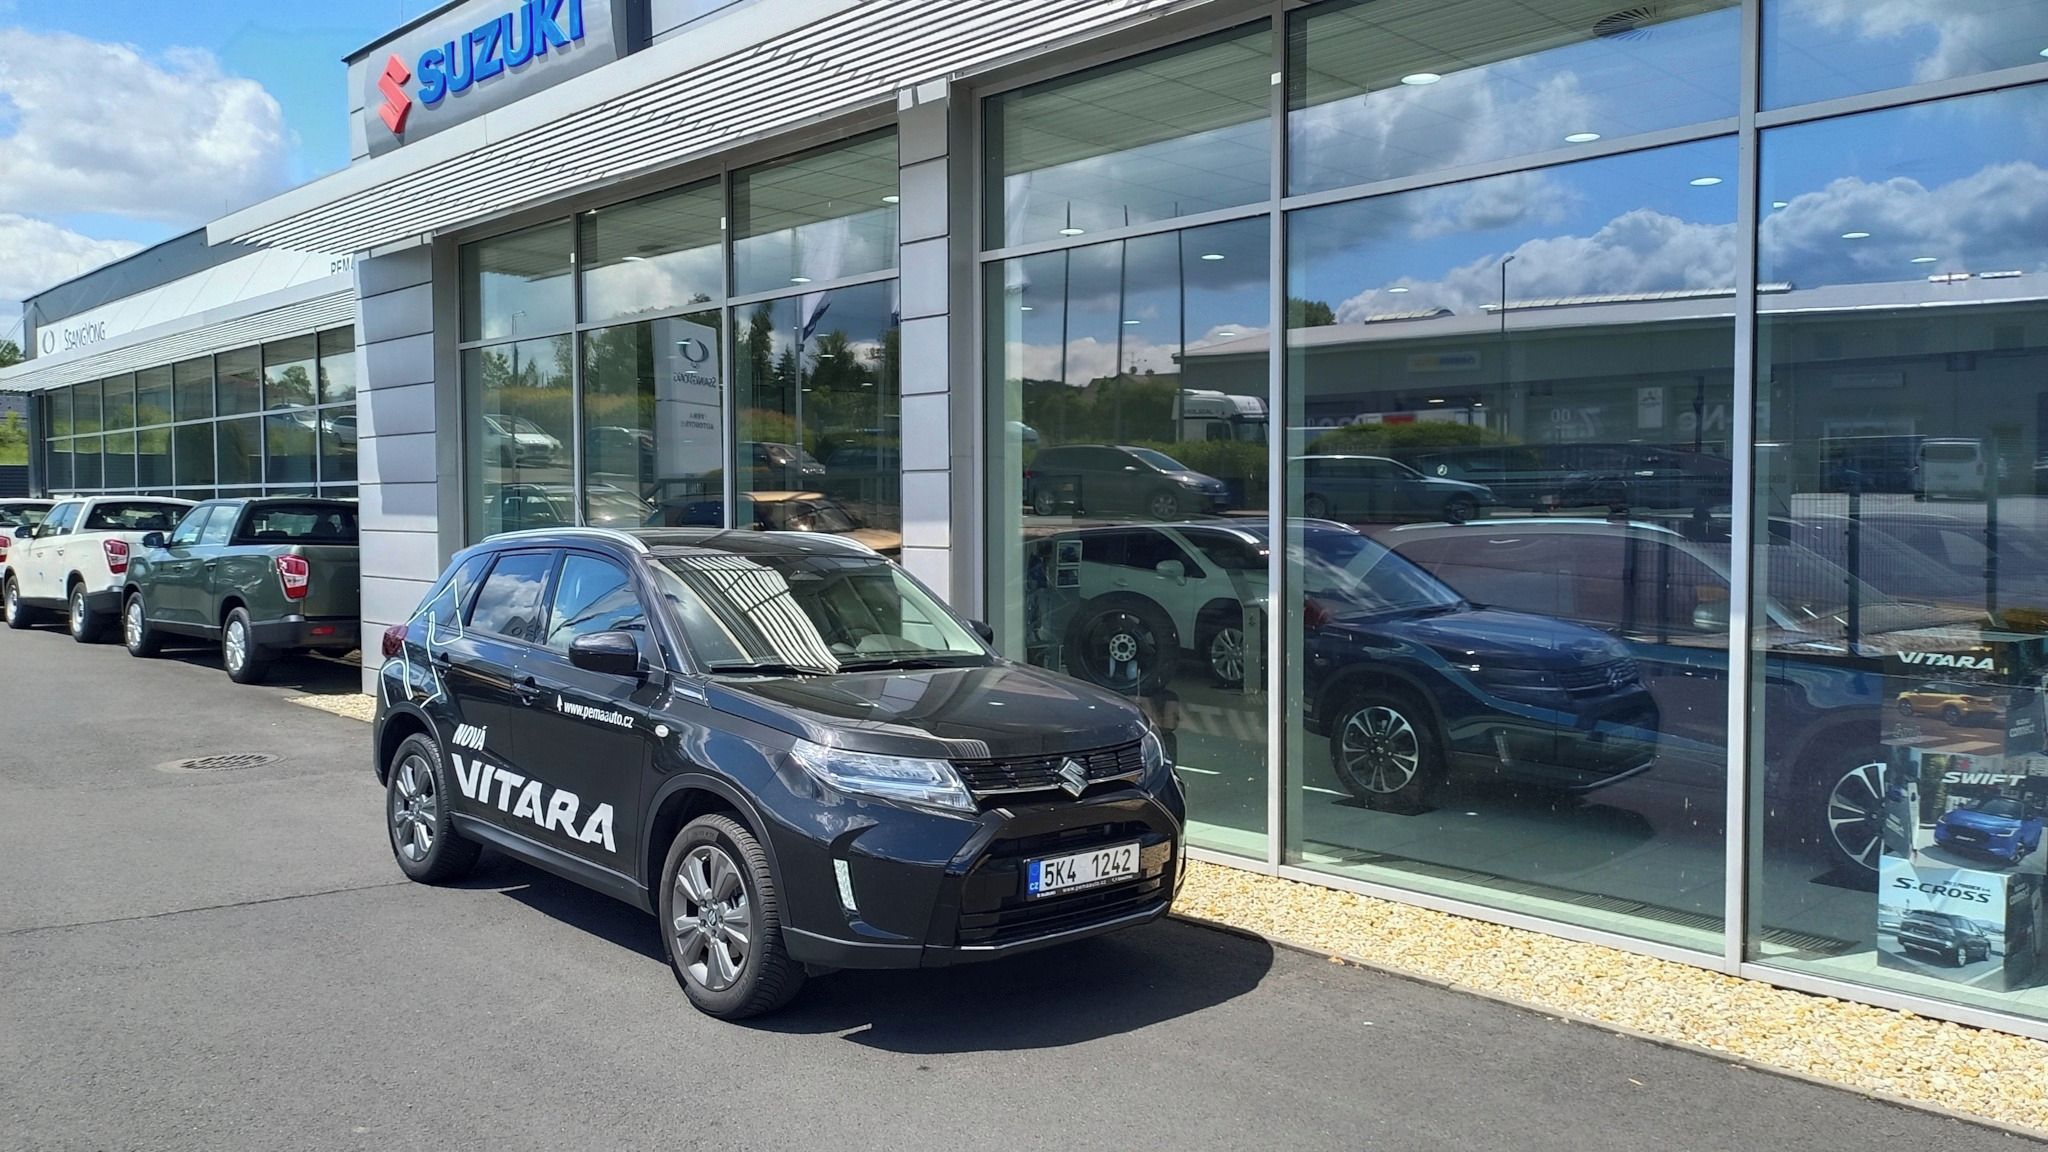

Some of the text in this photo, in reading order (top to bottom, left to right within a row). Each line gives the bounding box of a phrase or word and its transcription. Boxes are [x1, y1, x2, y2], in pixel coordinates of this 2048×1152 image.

[416, 0, 586, 104] SUZUKI
[1896, 650, 1995, 671] VITARA
[563, 702, 634, 729] www.pemaauto.cz
[451, 723, 488, 751] NOVÁ
[1941, 771, 2027, 786] SWIFT
[450, 752, 618, 853] VITARA
[1044, 848, 1131, 887] 5K4 1242
[1029, 882, 1039, 891] CZ
